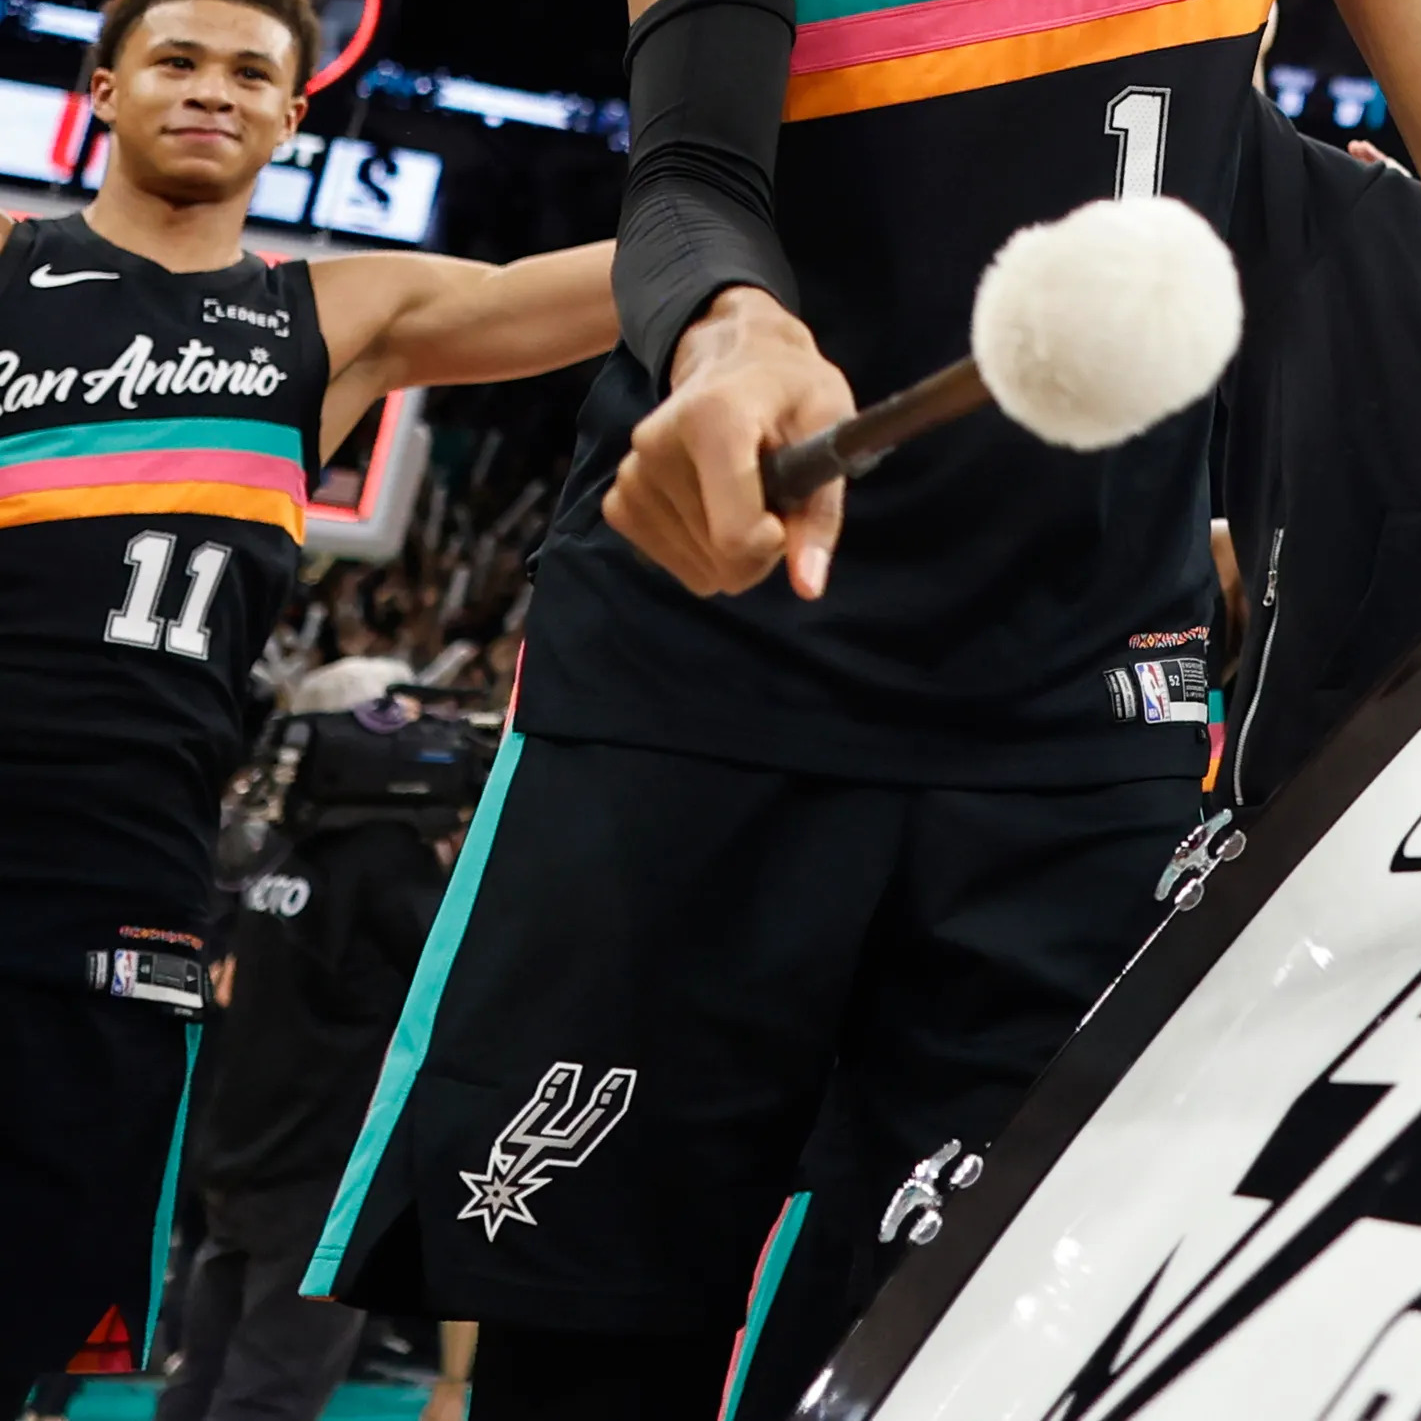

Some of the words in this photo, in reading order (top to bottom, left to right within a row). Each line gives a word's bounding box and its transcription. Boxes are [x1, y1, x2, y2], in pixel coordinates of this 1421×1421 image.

[1104, 85, 1172, 201] 1
[215, 304, 280, 329] LEDGER
[82, 334, 288, 410] Antonio
[104, 529, 232, 661] 11
[1168, 674, 1181, 687] 52
